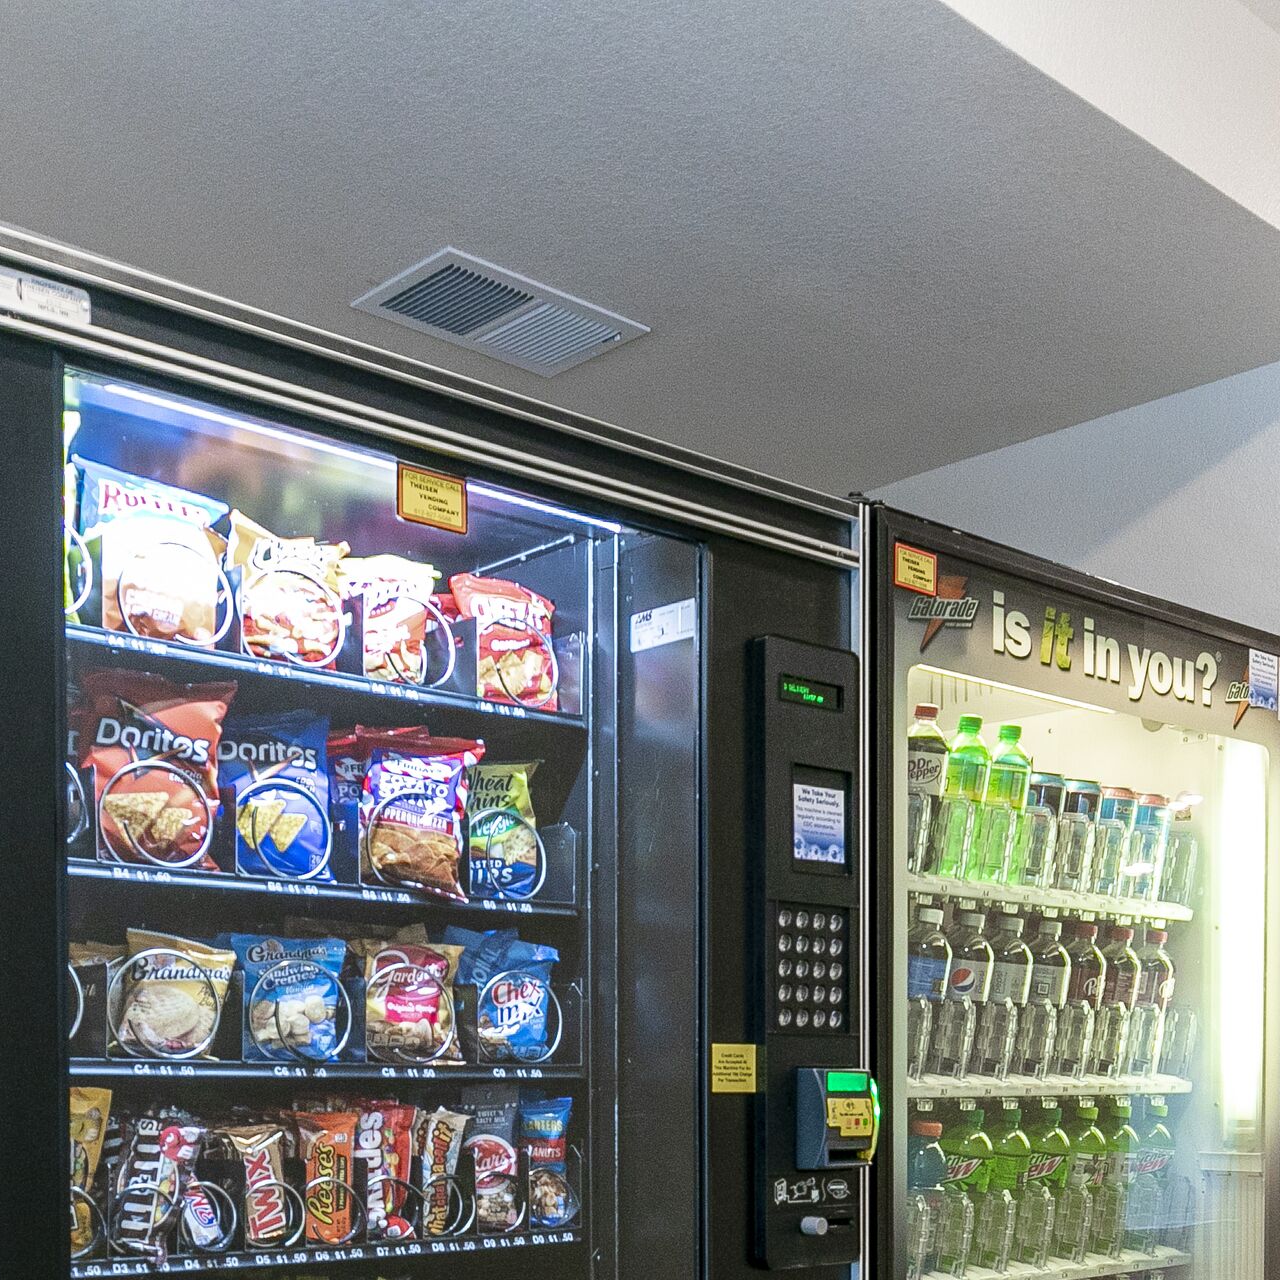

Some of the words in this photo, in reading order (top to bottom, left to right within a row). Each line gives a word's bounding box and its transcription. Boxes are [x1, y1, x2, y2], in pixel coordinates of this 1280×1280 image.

[410, 481, 438, 493] THEISEN
[419, 493, 448, 505] VENDING
[428, 504, 459, 516] COMPANY
[908, 595, 980, 621] Gatorade
[993, 590, 1032, 658] is
[1040, 606, 1074, 669] it
[1084, 616, 1121, 683] in
[1128, 643, 1218, 707] you?
[1226, 681, 1250, 701] Gato
[96, 718, 211, 763] Doritos
[217, 739, 317, 770] Doritos
[491, 978, 540, 1008] Chex
[245, 1150, 287, 1240] TWIX
[112, 1263, 128, 1274] D3
